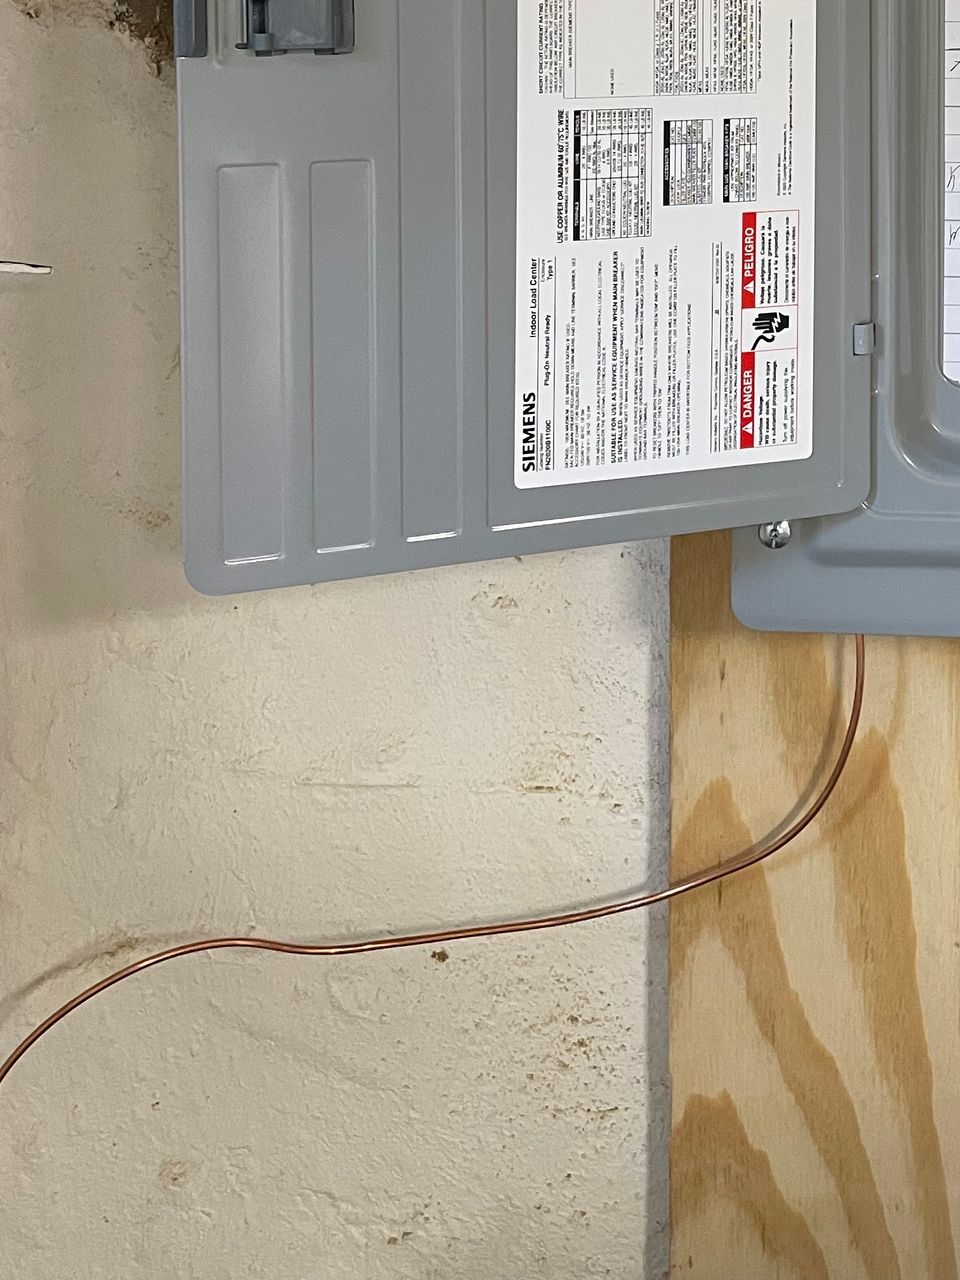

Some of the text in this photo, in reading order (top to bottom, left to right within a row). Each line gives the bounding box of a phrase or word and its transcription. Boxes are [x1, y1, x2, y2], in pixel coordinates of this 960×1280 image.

[743, 227, 755, 278] PELIGRO
[529, 258, 538, 338] Indoor Load Center
[742, 369, 753, 419] DANGER
[521, 391, 537, 473] SIEMENS
